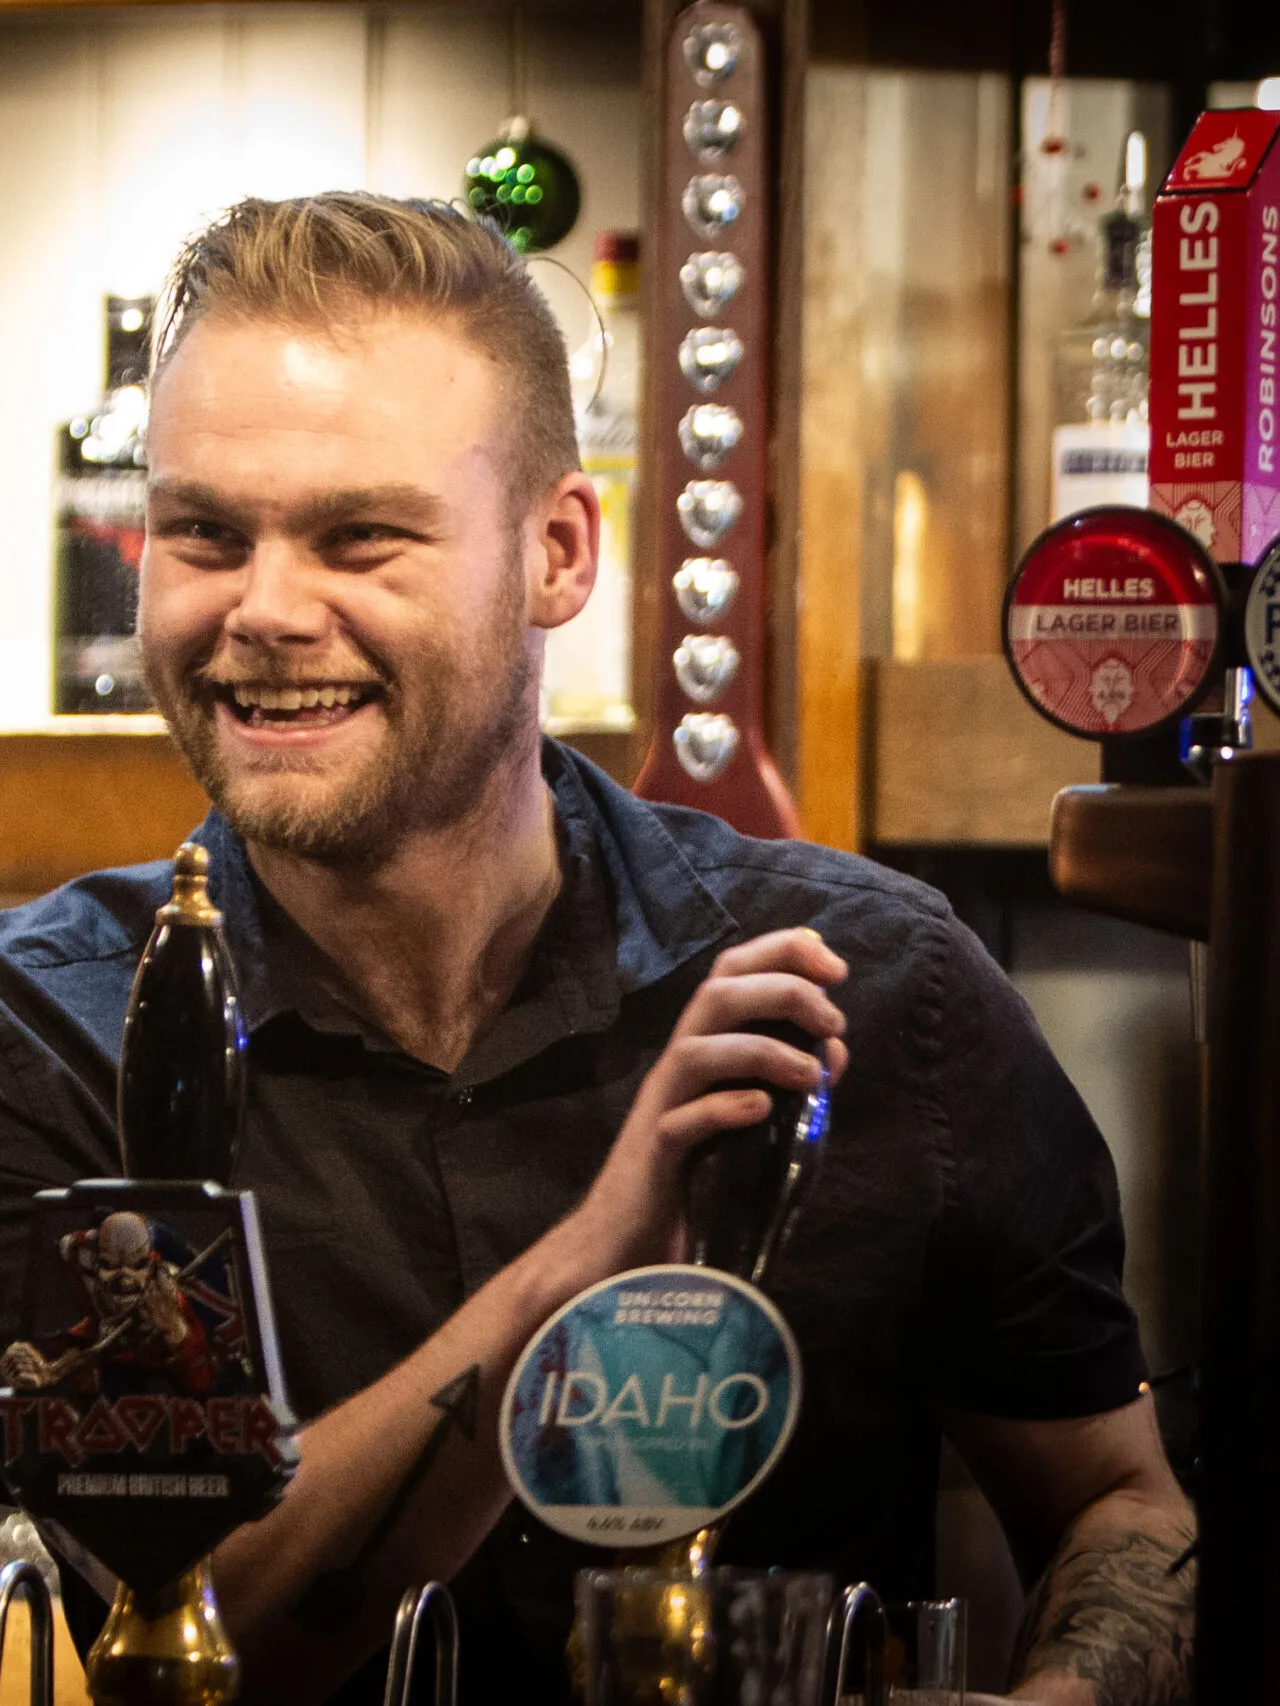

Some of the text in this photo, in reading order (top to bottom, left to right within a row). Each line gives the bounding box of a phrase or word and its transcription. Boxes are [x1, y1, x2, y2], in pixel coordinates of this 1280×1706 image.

[1177, 201, 1219, 420] HELLES
[1258, 205, 1278, 473] ROBINSONS
[1166, 430, 1224, 448] LAGER
[1174, 452, 1215, 469] BIER
[1063, 577, 1156, 599] HELLES
[1036, 613, 1180, 633] LAGER BIER
[539, 1371, 769, 1430] IDAHO
[57, 1474, 228, 1497] PREMIUM BRITISH BEER
